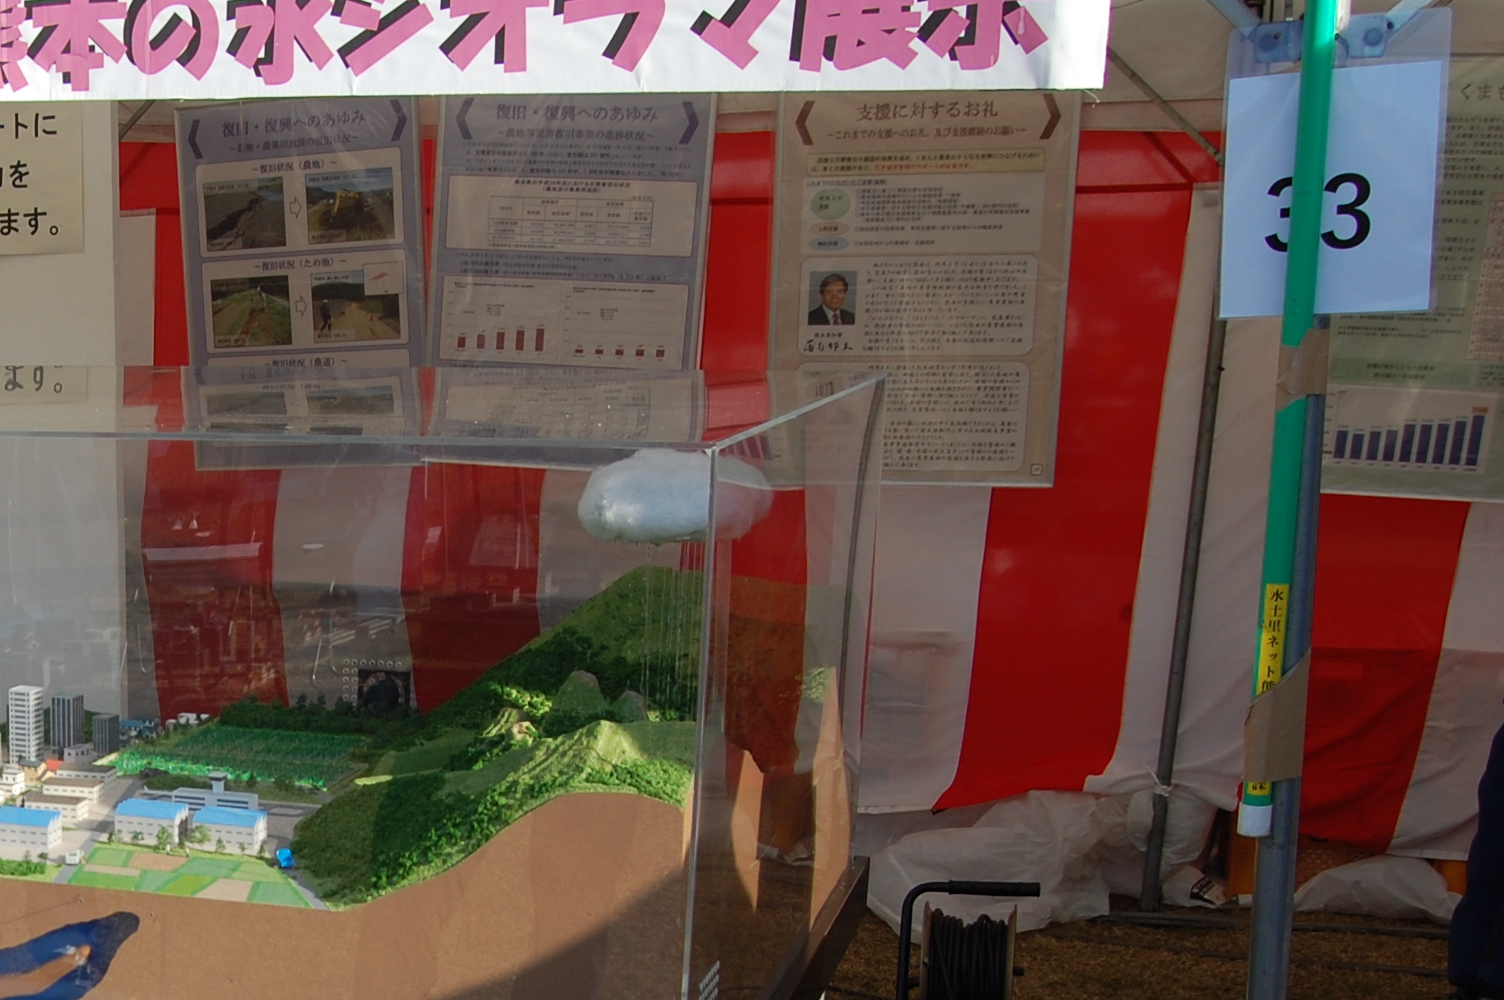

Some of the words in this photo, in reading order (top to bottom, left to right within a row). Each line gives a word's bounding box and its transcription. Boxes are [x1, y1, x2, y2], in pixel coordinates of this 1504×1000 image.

[495, 104, 658, 121] 復旧・復興へのあゆみ
[857, 101, 998, 121] 支援に対するお礼
[222, 110, 365, 138] 復旧・復興へのあゆみ
[1264, 172, 1371, 252] 33
